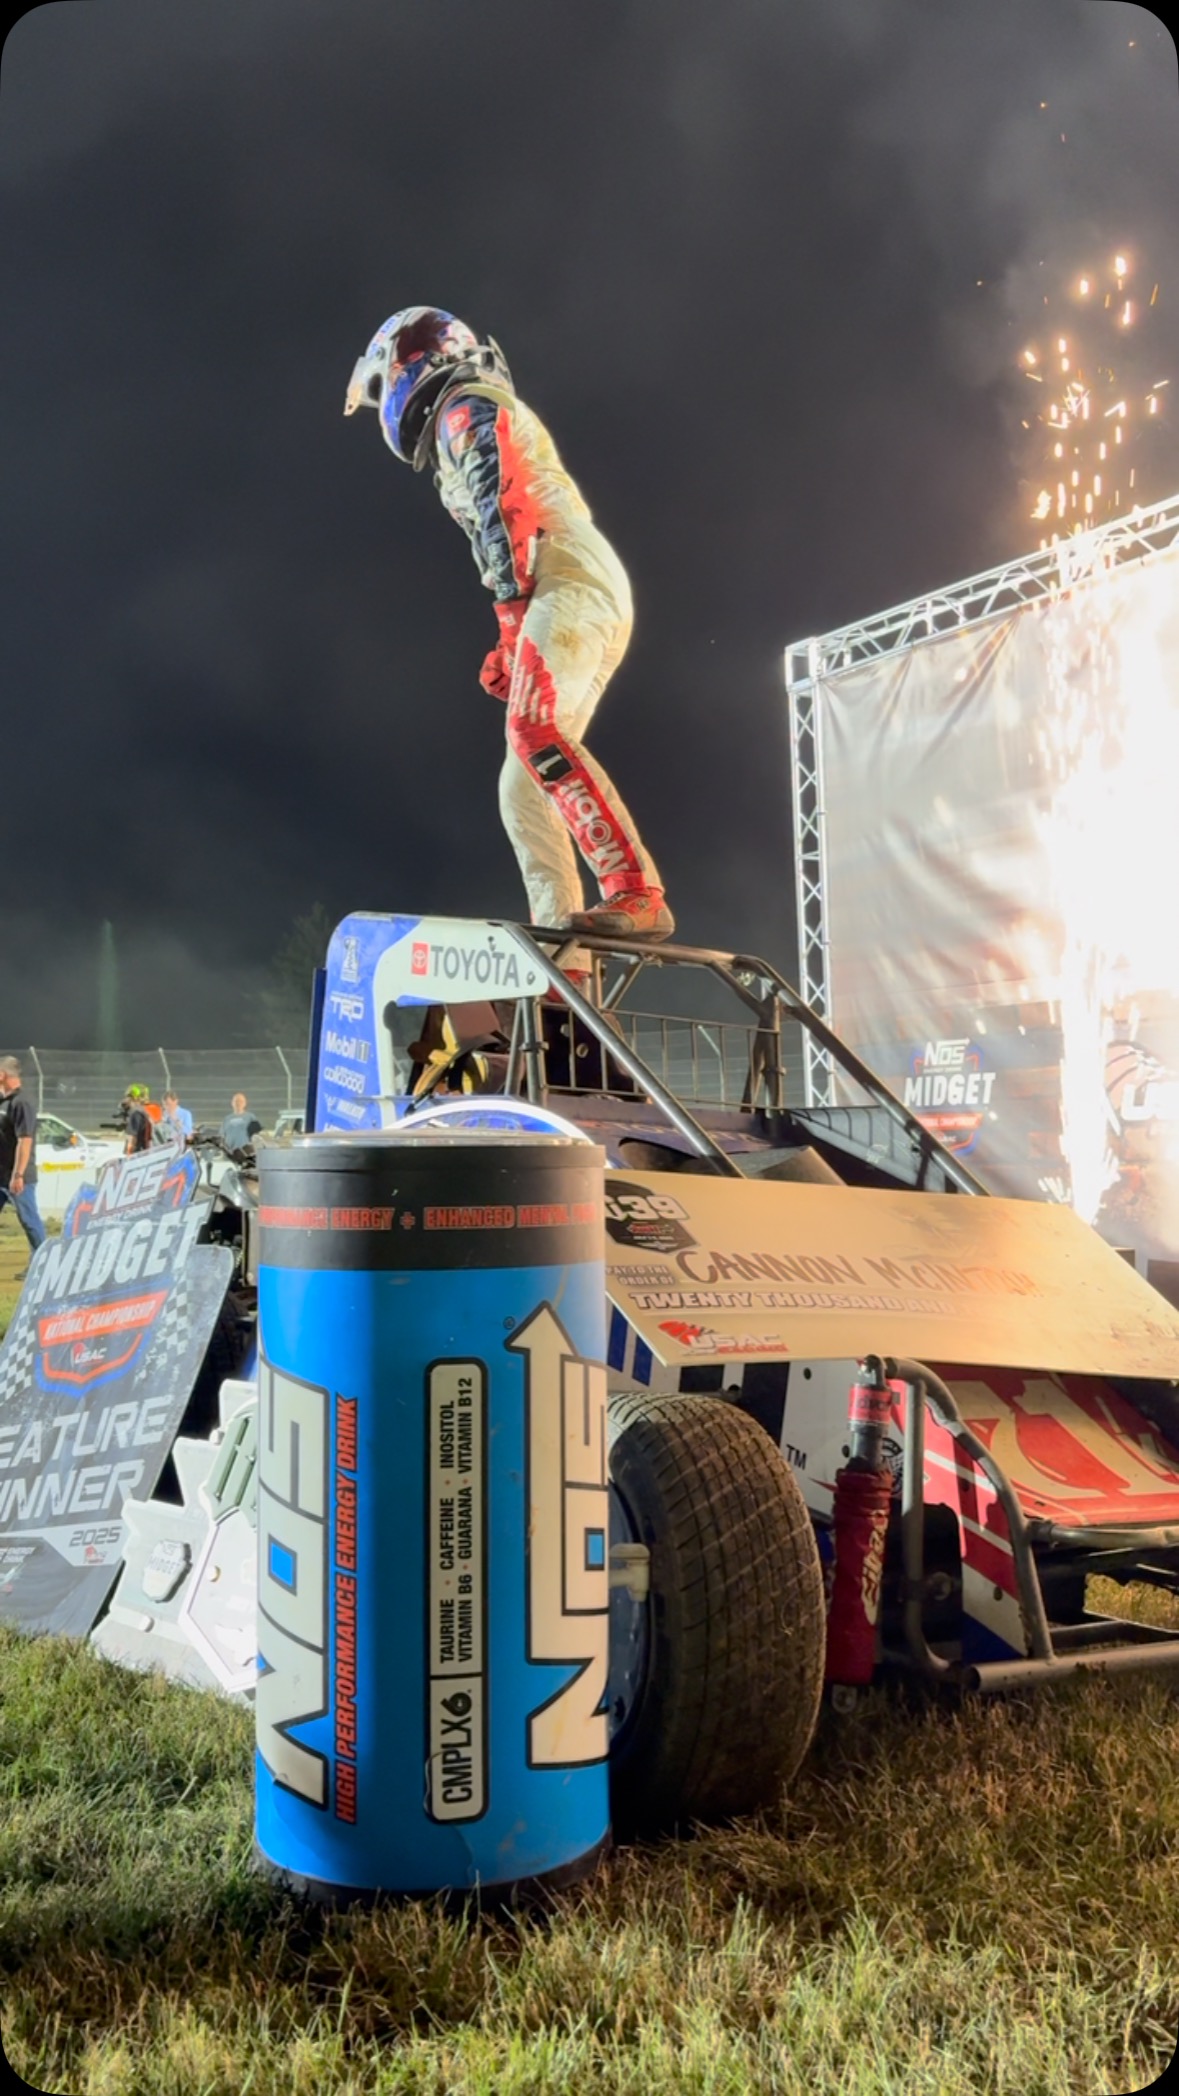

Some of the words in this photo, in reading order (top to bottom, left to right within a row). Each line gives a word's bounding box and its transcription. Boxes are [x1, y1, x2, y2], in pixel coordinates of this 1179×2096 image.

[430, 945, 520, 988] TOYOTA
[325, 1031, 356, 1059] Mobil
[923, 1038, 970, 1067] NOS
[904, 1072, 996, 1107] MIDGET
[91, 1142, 181, 1216] NOS
[331, 1207, 395, 1230] ENERGY
[424, 1206, 515, 1230] ENHANCED
[34, 1203, 210, 1305] MIDGET
[676, 1250, 866, 1285] CANNON
[629, 1292, 753, 1310] TWENTY
[757, 1292, 905, 1312] THOUSAND
[458, 1378, 472, 1407] B12
[335, 1392, 358, 1473] DRINK
[440, 1401, 454, 1468] INOSITOL
[458, 1412, 472, 1474] VITAMIN
[786, 1444, 807, 1470] TM
[68, 1526, 122, 1548] 2025
[335, 1470, 358, 1572] ENERGY
[440, 1498, 454, 1570] CAFFEINE
[458, 1486, 472, 1559] GUARANA
[458, 1574, 472, 1594] B6
[440, 1599, 454, 1664] TAURINE
[458, 1600, 472, 1662] VITAMIN
[335, 1572, 358, 1760] PERFORMANCE
[441, 1691, 472, 1804] CMPLX6
[335, 1758, 358, 1825] HIGH
